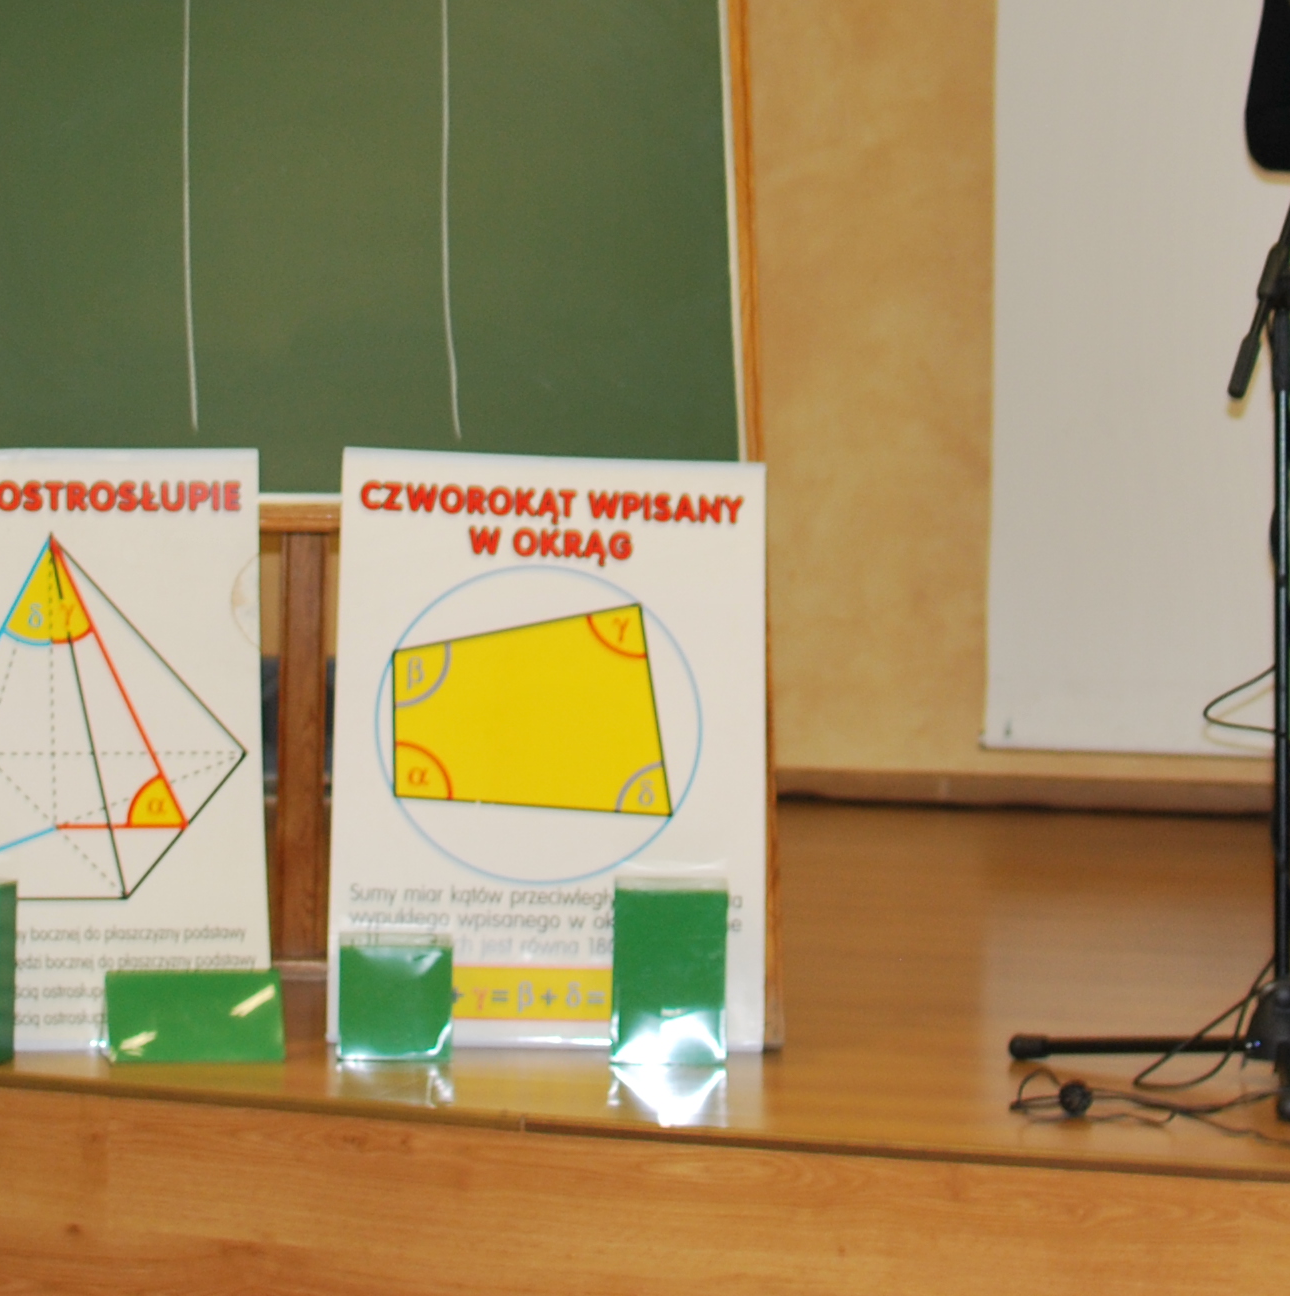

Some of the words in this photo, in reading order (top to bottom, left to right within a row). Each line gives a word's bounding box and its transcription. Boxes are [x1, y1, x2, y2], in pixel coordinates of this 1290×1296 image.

[360, 479, 578, 526] CZWOROKĄT
[587, 489, 745, 525] WPISANY
[469, 525, 502, 555] W
[512, 527, 634, 567] OKRĄG
[349, 882, 397, 906] Sumy
[403, 884, 443, 902] miar
[449, 884, 503, 906] kątów
[458, 910, 562, 933] wpisanego
[30, 926, 80, 944] bocznej
[84, 927, 101, 941] do
[184, 925, 247, 943] podstawy
